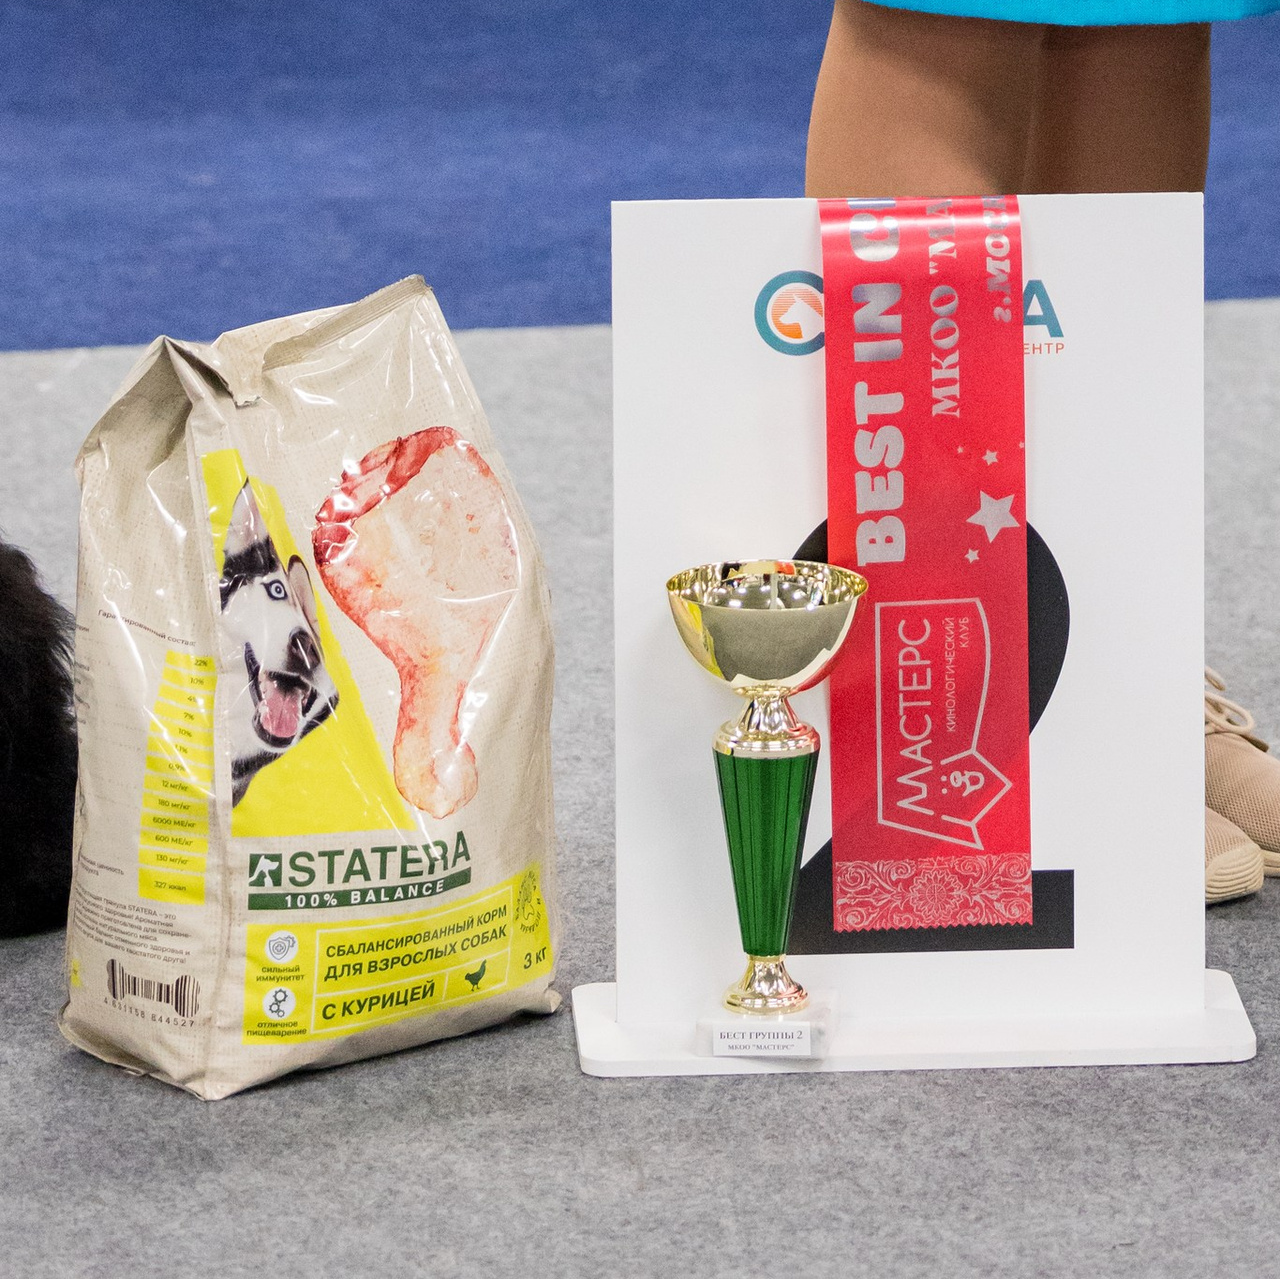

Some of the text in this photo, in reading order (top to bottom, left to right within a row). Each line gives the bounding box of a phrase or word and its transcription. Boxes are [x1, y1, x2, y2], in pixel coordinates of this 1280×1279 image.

[929, 285, 960, 418] МКОО
[1023, 342, 1065, 355] ЕНТР
[847, 197, 906, 567] BEST IN C
[98, 609, 167, 639] Гаратированный
[958, 616, 970, 648] КЛУБ
[189, 677, 204, 686] 10%
[941, 617, 956, 733] КИНОЛОГИЧЕСКИЙ
[183, 712, 194, 722] 7%
[178, 727, 193, 738] 10%
[161, 779, 189, 792] 12 мг/кг
[158, 798, 191, 811] 180 мг/кг
[152, 816, 196, 829] 6000 МЕ/кг
[155, 834, 193, 847] 600 МЕ/кг
[156, 853, 189, 866] 130 мг/кг
[288, 830, 472, 888] STATERA
[154, 880, 167, 889] 327
[285, 879, 445, 909] 100% BALANCE
[128, 904, 158, 917] STATERA
[134, 915, 174, 928] Ароматная
[325, 904, 508, 959] СБАЛАНСИРОВАННЫЙ КОРМ
[324, 924, 508, 982] ДЛЯ ВЗРОСЛЫХ СОБАК
[523, 952, 532, 969] 3
[261, 965, 301, 975] сильный
[255, 974, 305, 983] иммунитет
[321, 982, 437, 1021] С КУРИЦЕЙ
[151, 1014, 195, 1028] 844527
[257, 1020, 299, 1029] отличное
[246, 1027, 308, 1039] пищеварение
[719, 1030, 803, 1040] БЕСТ ГРУППЫ 2
